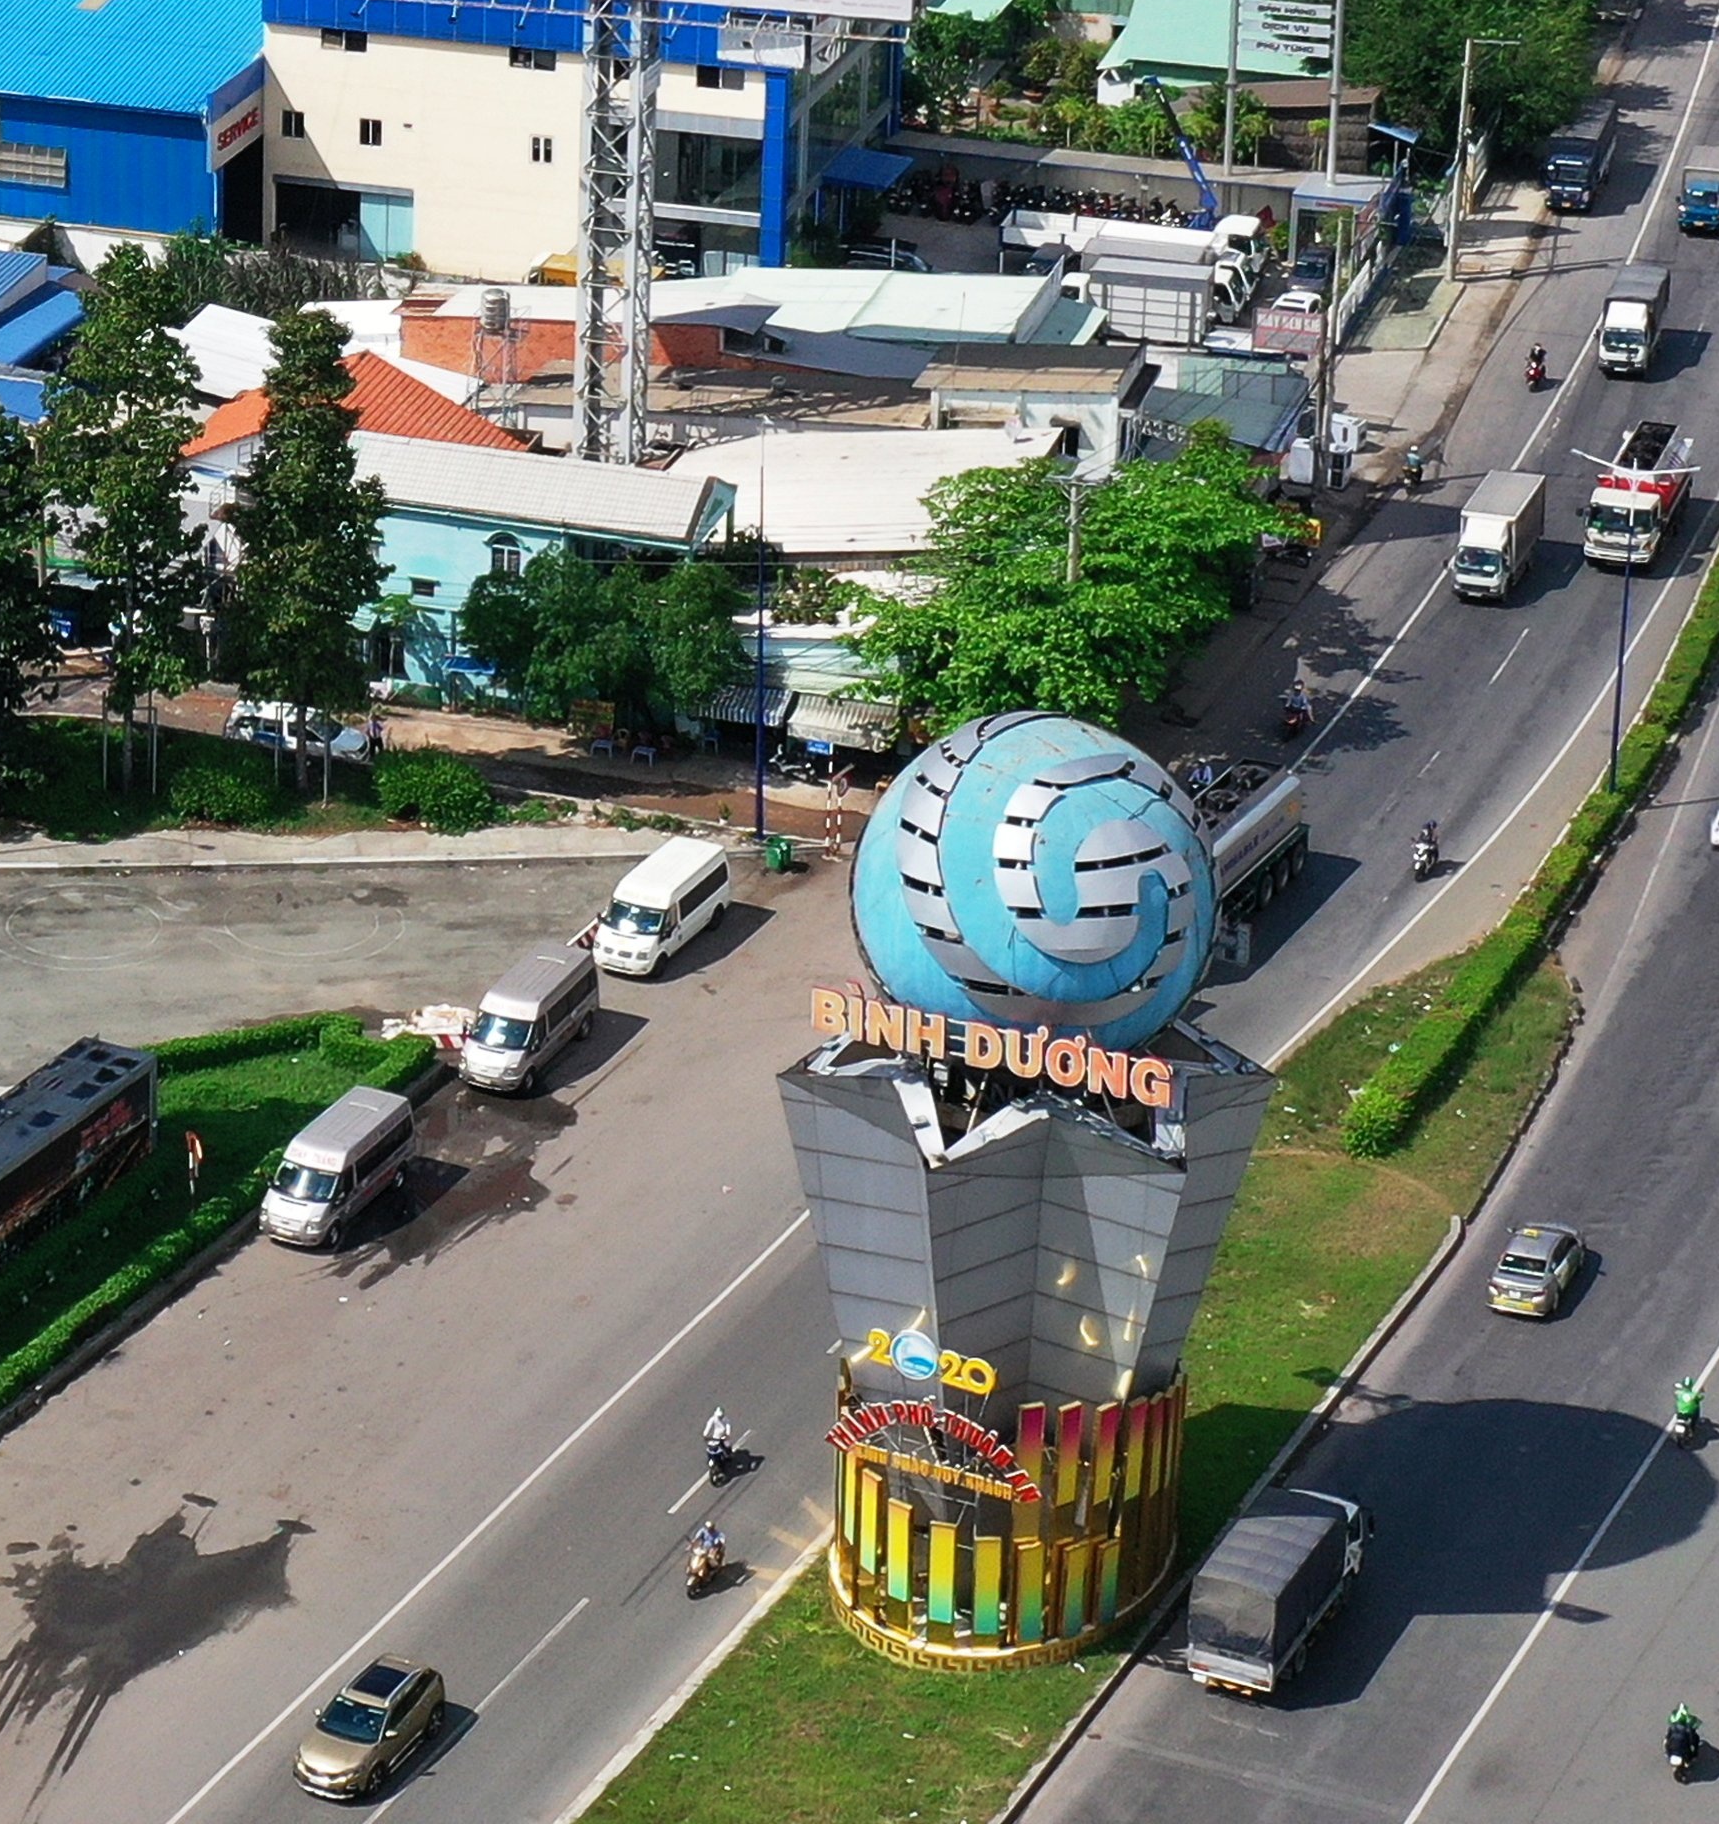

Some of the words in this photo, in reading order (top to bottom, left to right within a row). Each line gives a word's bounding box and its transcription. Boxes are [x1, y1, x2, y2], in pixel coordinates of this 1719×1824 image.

[217, 107, 261, 151] SERVICE
[810, 981, 947, 1060] BÌNH
[964, 1020, 1174, 1108] DƯƠNG
